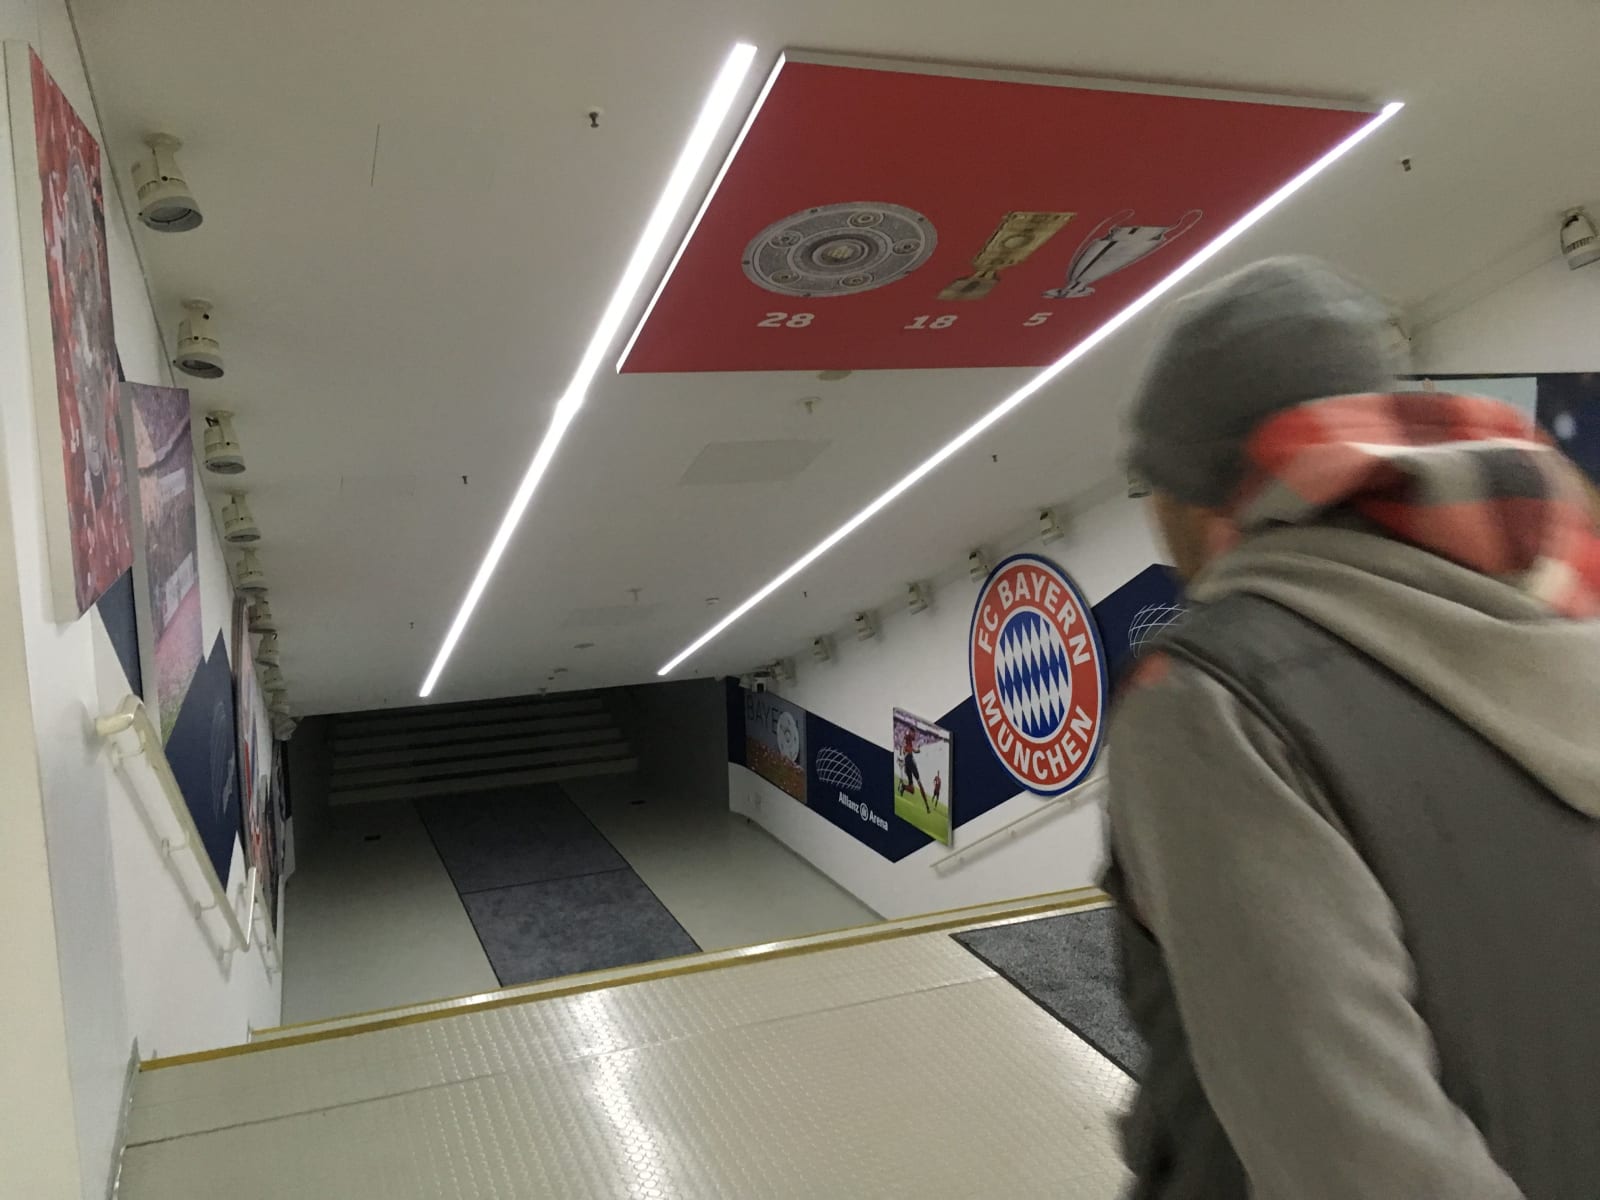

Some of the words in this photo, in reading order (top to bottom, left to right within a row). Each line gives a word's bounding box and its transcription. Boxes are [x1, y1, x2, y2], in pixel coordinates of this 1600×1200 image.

[757, 312, 815, 328] 28
[904, 315, 958, 329] 18
[1023, 312, 1052, 326] 5
[978, 605, 999, 654] FC
[997, 571, 1091, 666] BAYERN
[747, 694, 799, 736] BAYE
[982, 689, 1093, 781] MÜNCHEN
[839, 791, 859, 814] Allianz
[869, 810, 888, 832] Arena
